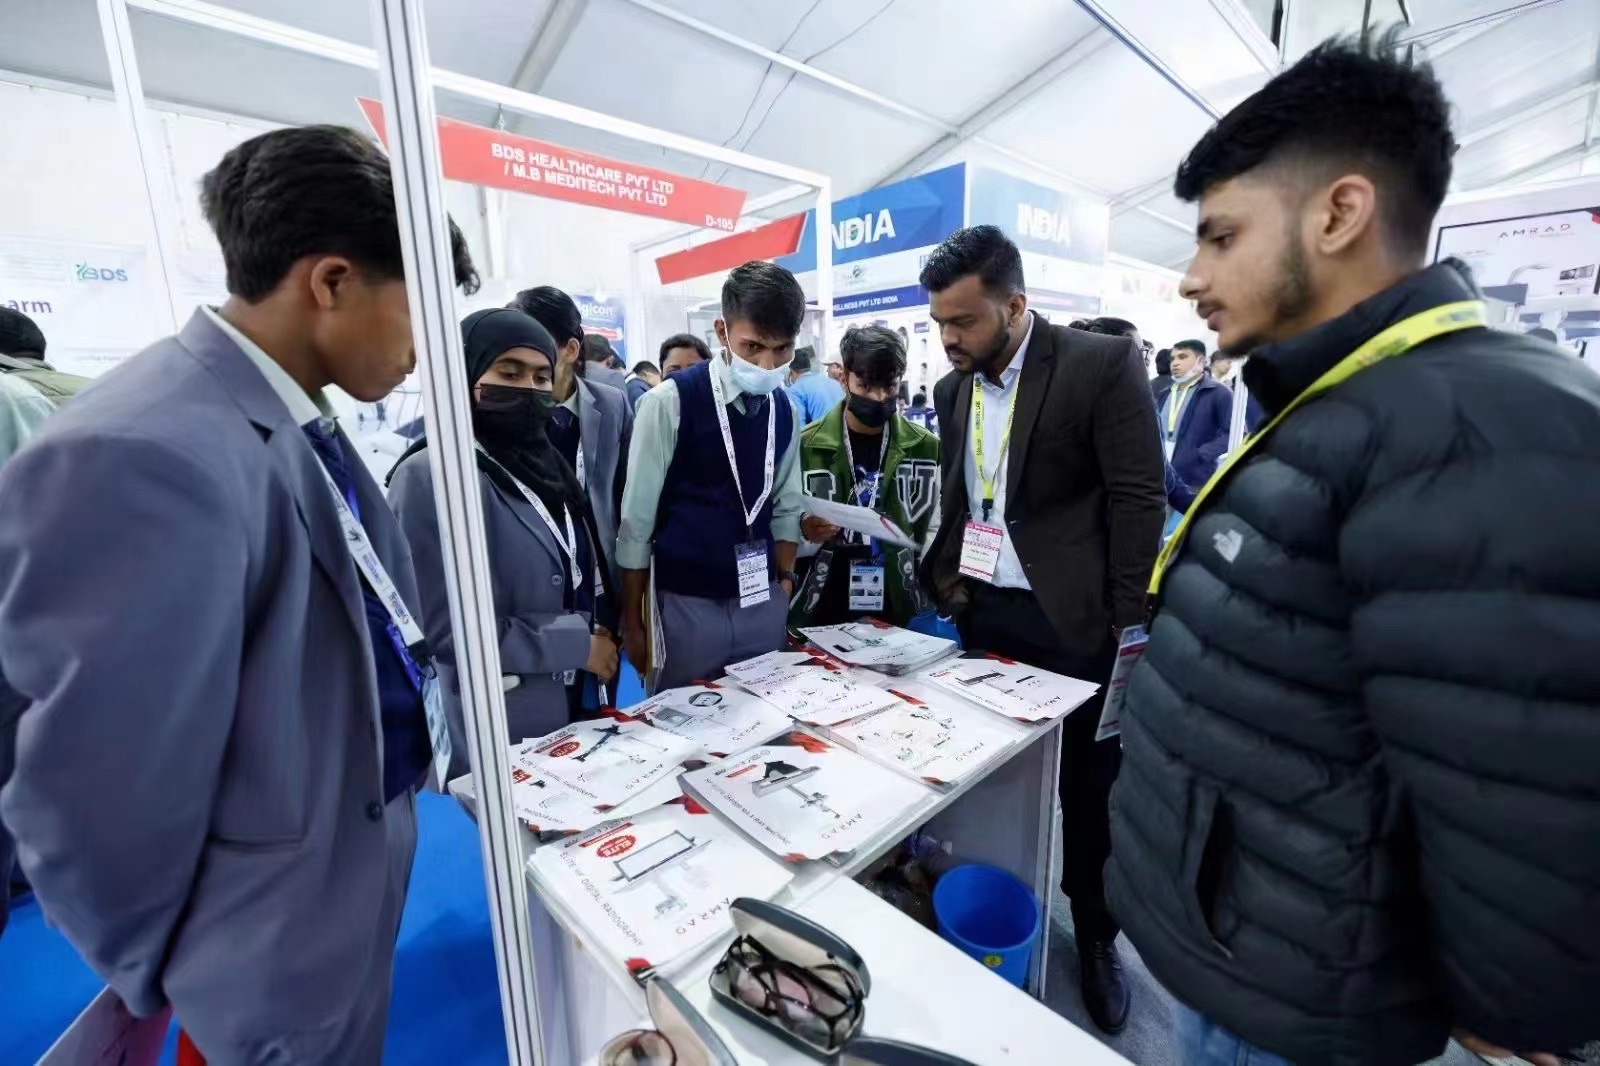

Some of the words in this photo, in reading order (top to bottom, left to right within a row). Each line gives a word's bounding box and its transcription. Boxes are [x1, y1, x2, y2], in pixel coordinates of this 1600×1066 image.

[491, 143, 525, 162] BDS
[528, 152, 622, 184] HEALTHCARE
[625, 172, 650, 189] PVT
[652, 179, 674, 195] LTD
[512, 163, 541, 181] M.B
[544, 170, 616, 197] MEDITECH
[618, 185, 643, 201] PVT
[645, 191, 668, 207] LTD
[705, 213, 734, 230] D-105
[831, 208, 896, 250] NDIA
[1017, 203, 1071, 245] INDIA
[1499, 223, 1571, 239] AMRAD
[0, 299, 52, 313] arm
[579, 302, 613, 317] gicon
[859, 300, 869, 308] PVT
[870, 297, 882, 306] LTD
[882, 295, 898, 304] INDIA
[602, 838, 635, 857] ELITE
[602, 902, 644, 946] RADIOGRAPHY
